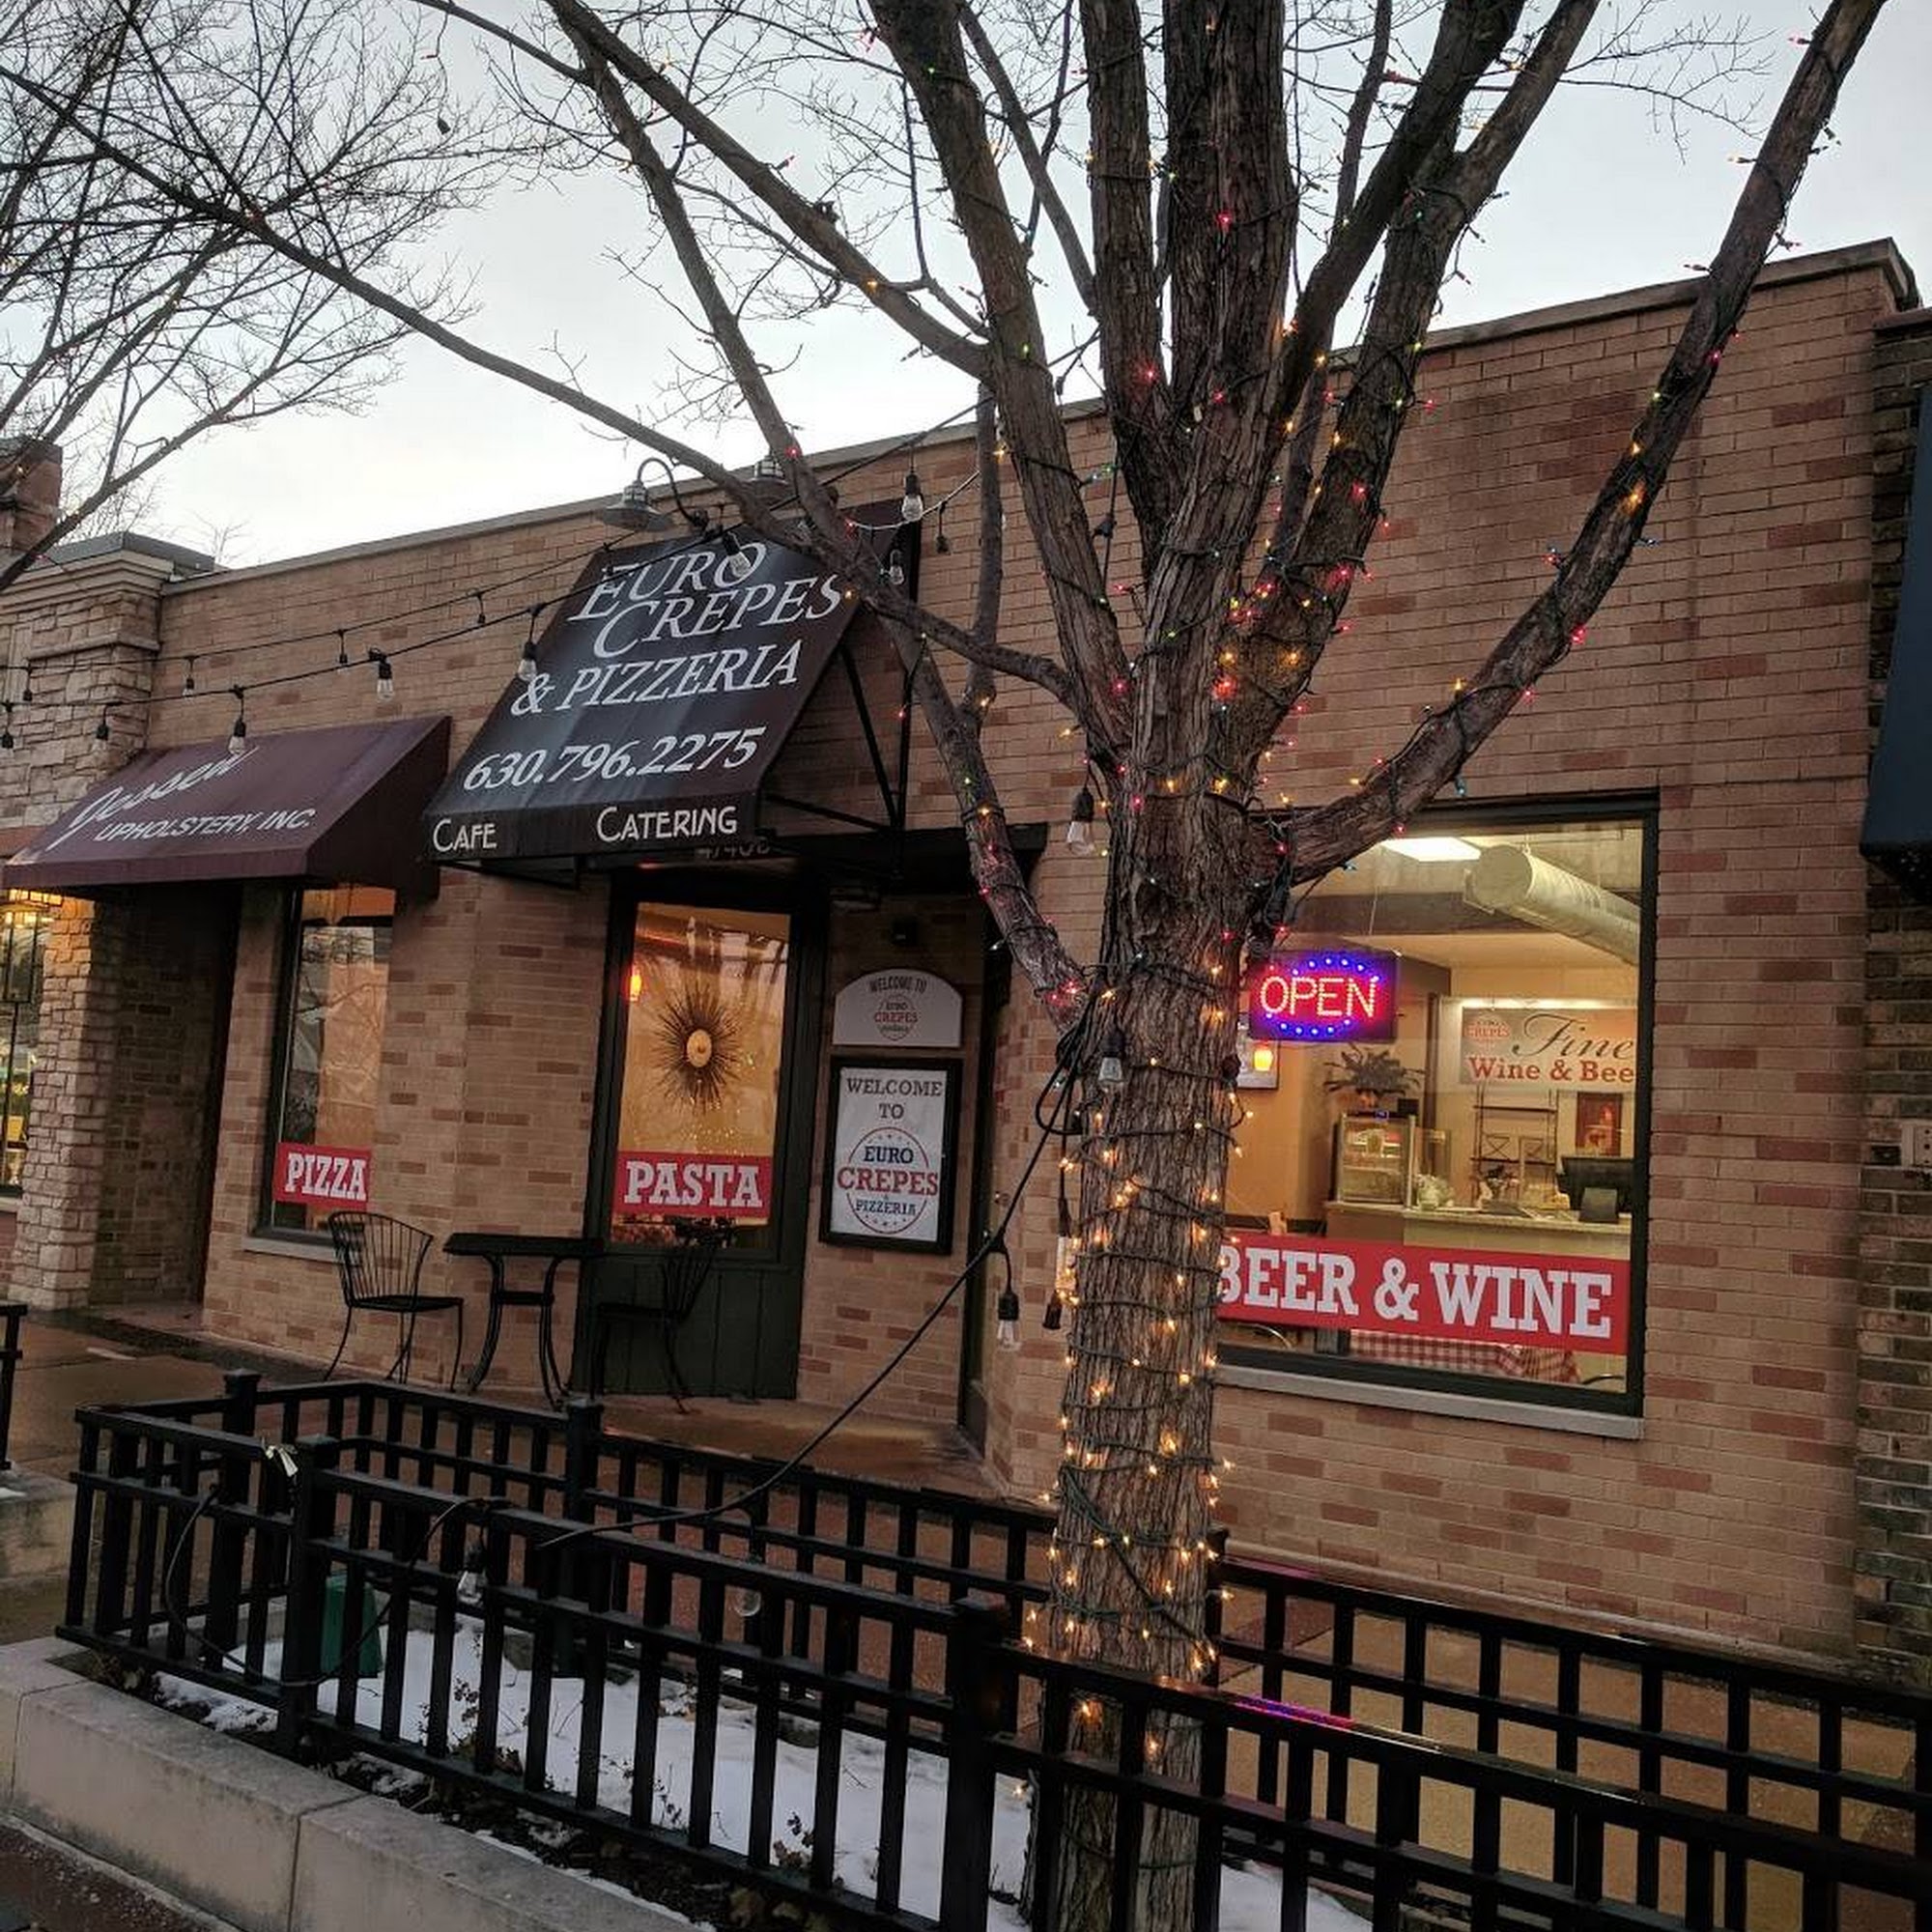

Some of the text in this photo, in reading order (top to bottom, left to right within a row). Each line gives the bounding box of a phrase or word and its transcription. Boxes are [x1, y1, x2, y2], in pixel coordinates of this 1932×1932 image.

[567, 542, 767, 621] EURO
[593, 574, 841, 658] CREPES
[510, 639, 803, 717] & PIZZERIA
[463, 726, 767, 791] 630.796.2275
[258, 809, 318, 830] INC.
[432, 818, 497, 852] CAFE
[597, 806, 738, 843] CATERING
[1258, 975, 1378, 1019] OPEN
[1512, 1013, 1634, 1060] Fine
[846, 1077, 943, 1097] WELCOME
[1468, 1056, 1541, 1081] Wine
[1549, 1059, 1572, 1082] &
[878, 1103, 904, 1120] TO
[864, 1146, 914, 1164] EURO
[285, 1152, 367, 1201] PIZZA
[623, 1160, 763, 1208] PASTA
[838, 1166, 938, 1196] CREPES
[856, 1199, 917, 1216] PIZZERIA
[1217, 1244, 1612, 1339] BEER & WINE
